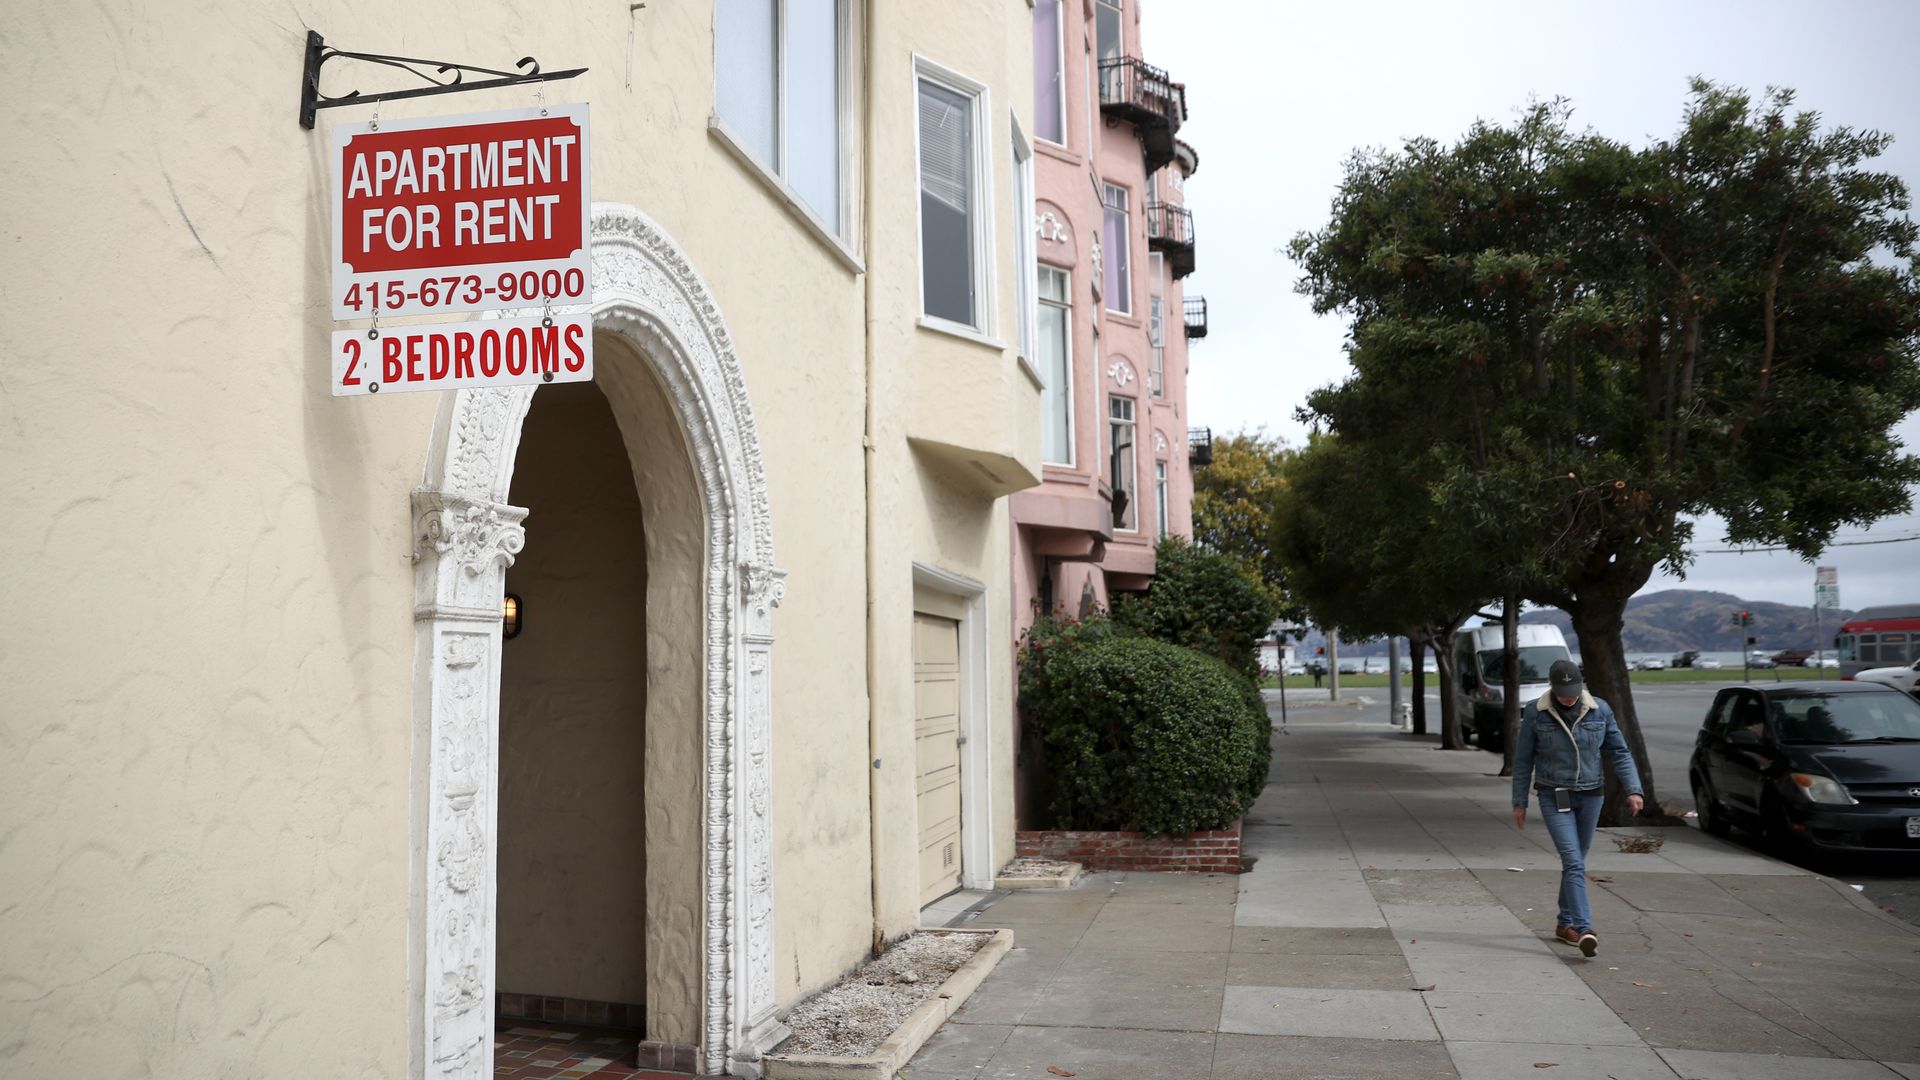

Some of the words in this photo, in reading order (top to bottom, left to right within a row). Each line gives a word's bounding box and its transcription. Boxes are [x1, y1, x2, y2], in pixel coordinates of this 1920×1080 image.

[347, 134, 577, 199] APARTMENT
[362, 204, 441, 253] FOR
[454, 194, 561, 246] RENT
[343, 267, 585, 311] 415-673-9000
[342, 338, 362, 386] 2
[382, 323, 586, 384] BEDROOMS
